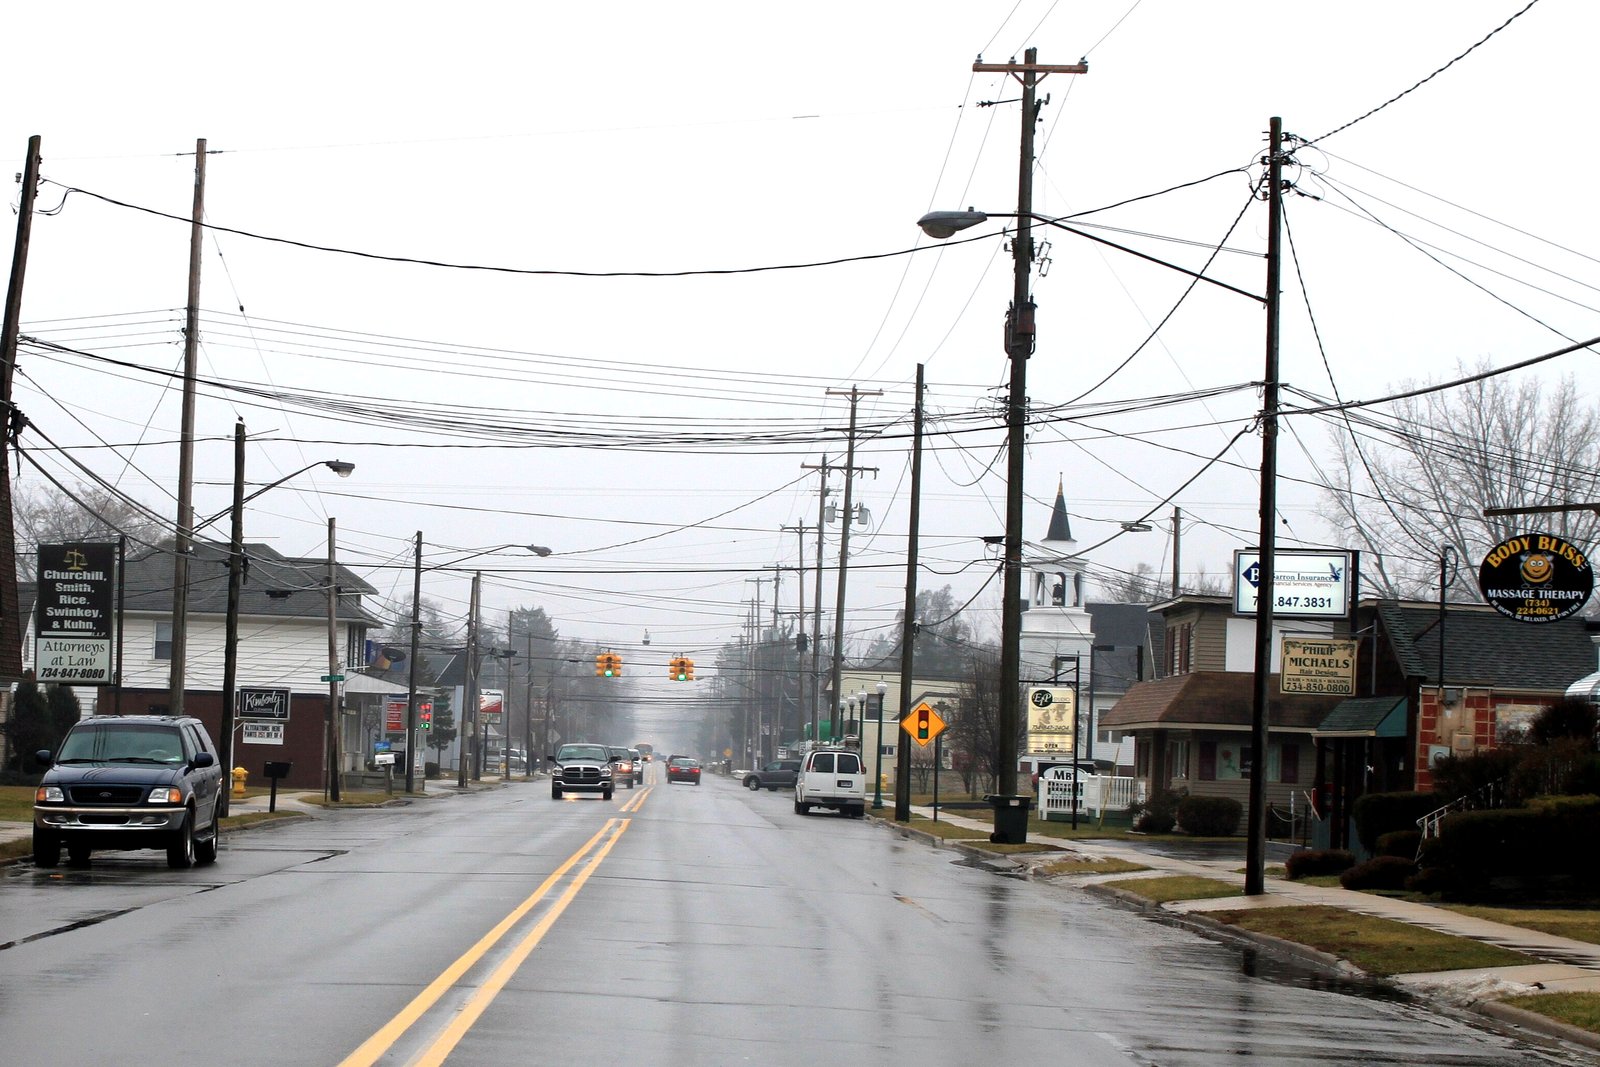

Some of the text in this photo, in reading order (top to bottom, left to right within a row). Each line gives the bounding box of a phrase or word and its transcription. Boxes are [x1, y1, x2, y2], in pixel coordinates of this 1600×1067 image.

[1486, 536, 1530, 568] BODY
[1537, 535, 1585, 567] BLISS
[43, 569, 107, 581] Churchill,
[1272, 572, 1333, 581] arron Insurance
[55, 582, 95, 593] Smith,
[1314, 581, 1333, 589] Agency
[1487, 589, 1585, 600] MASSAGE THERAPY
[1524, 599, 1550, 607] (734)
[1516, 607, 1559, 615] 224-0621
[52, 620, 60, 629] &
[43, 640, 105, 656] Attorneys
[1302, 646, 1336, 655] PHILIP
[50, 655, 96, 666] at Law
[1289, 657, 1350, 669] MICHAELS
[1315, 669, 1338, 677] Design
[1286, 682, 1350, 692] 734-850-0800
